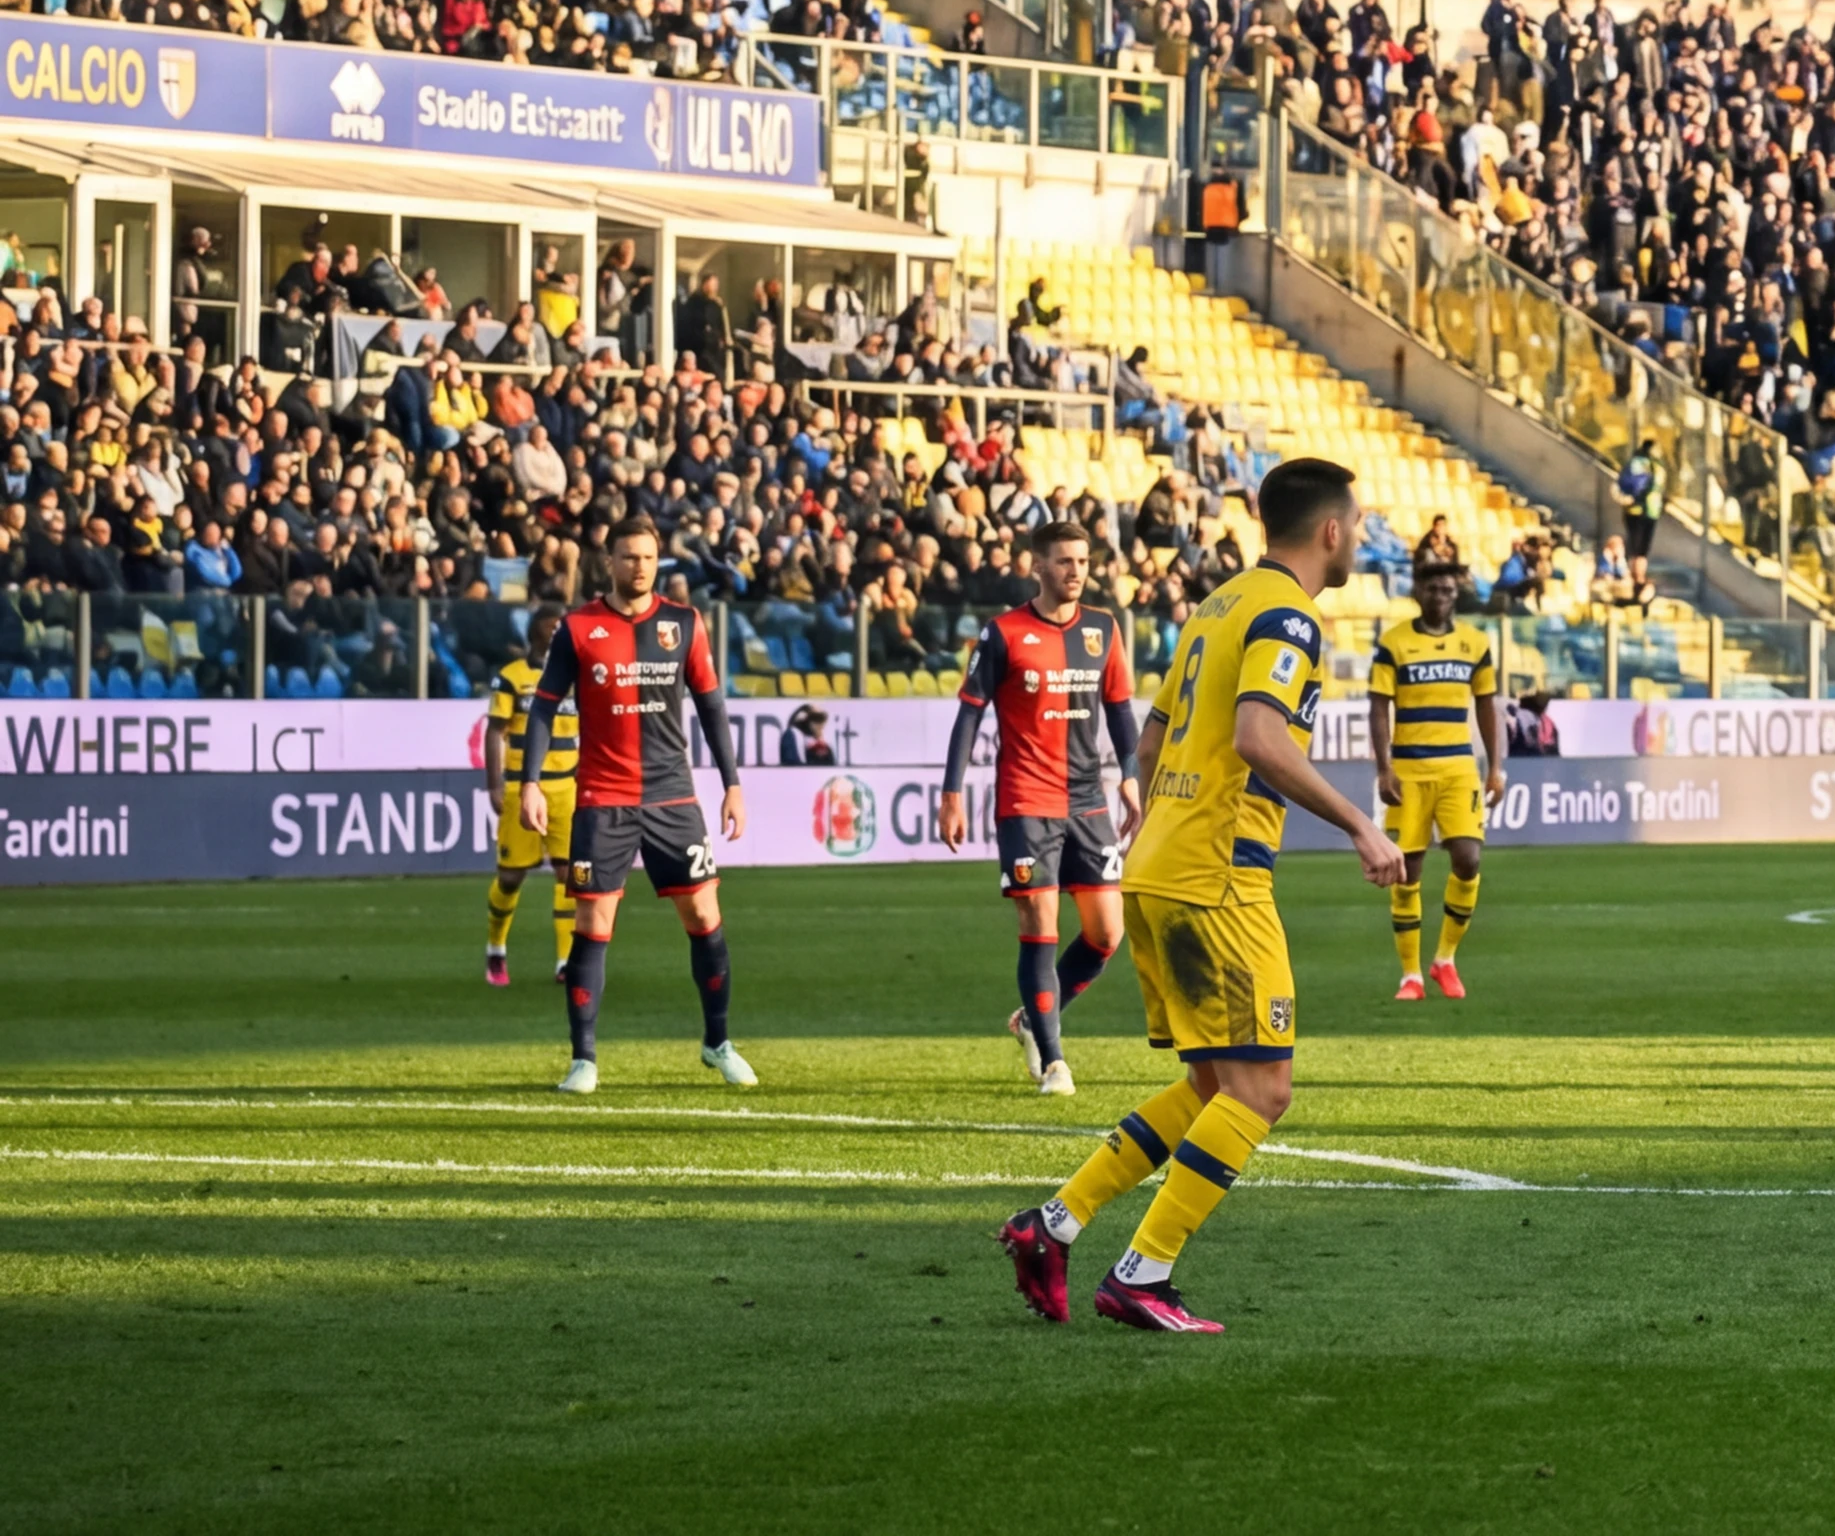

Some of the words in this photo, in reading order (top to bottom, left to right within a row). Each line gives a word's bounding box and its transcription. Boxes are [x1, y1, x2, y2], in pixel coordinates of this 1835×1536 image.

[7, 38, 146, 109] CALCIO
[418, 84, 506, 133] Stadio
[269, 791, 463, 857] STAND
[1540, 780, 1620, 825] Ennio
[1625, 777, 1720, 823] Tardini
